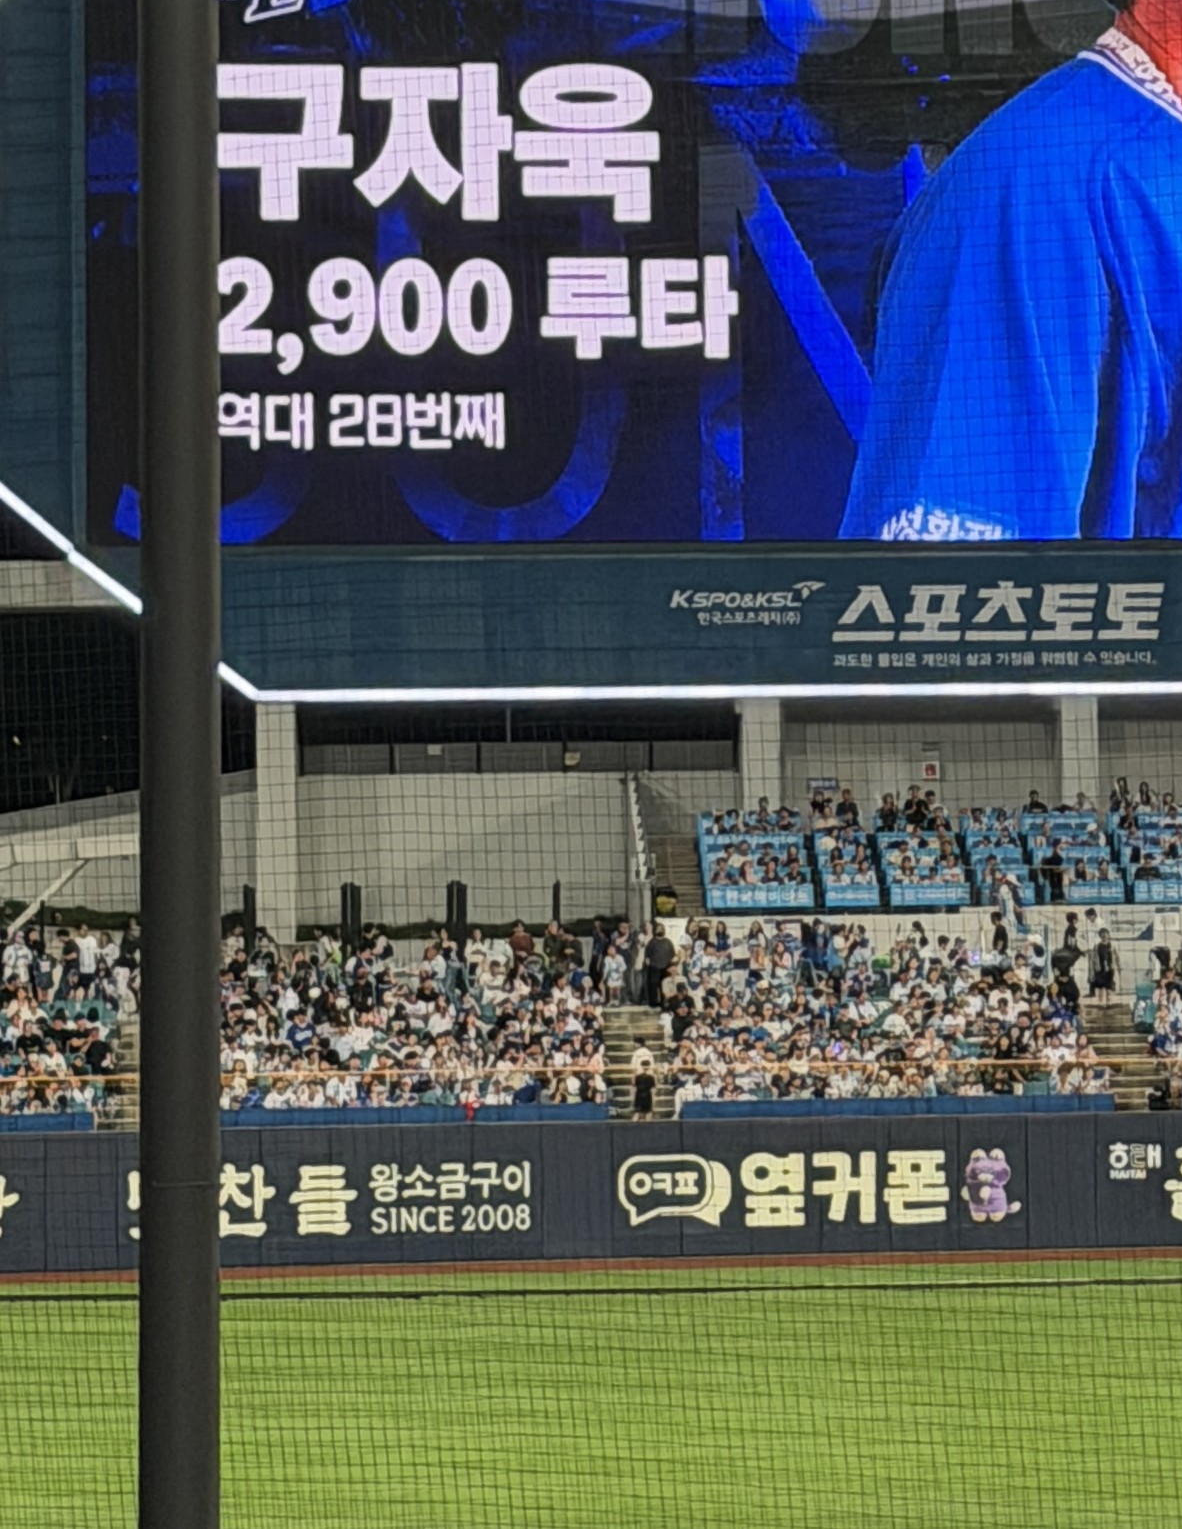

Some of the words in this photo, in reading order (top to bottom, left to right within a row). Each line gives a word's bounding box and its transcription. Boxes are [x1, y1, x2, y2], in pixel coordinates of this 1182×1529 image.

[217, 63, 660, 223] 구자욱
[218, 256, 512, 375] 2,900
[540, 255, 739, 359] 루타
[218, 392, 314, 451] 역대
[329, 391, 505, 451] 28번째
[669, 589, 802, 608] KSPO&KSL
[832, 581, 1165, 642] 스포츠토토
[833, 652, 872, 667] 과도한
[878, 652, 917, 667] 몰입은
[922, 652, 961, 667] 개인의
[966, 652, 992, 667] 삶과
[995, 651, 1035, 666] 가정을
[1083, 651, 1097, 665] 수
[1100, 650, 1158, 666] 있습니다.
[368, 1160, 531, 1203] 왕소금구이
[739, 1149, 950, 1228] 옆커폰
[370, 1205, 456, 1234] SINCE
[461, 1203, 531, 1231] 2008
